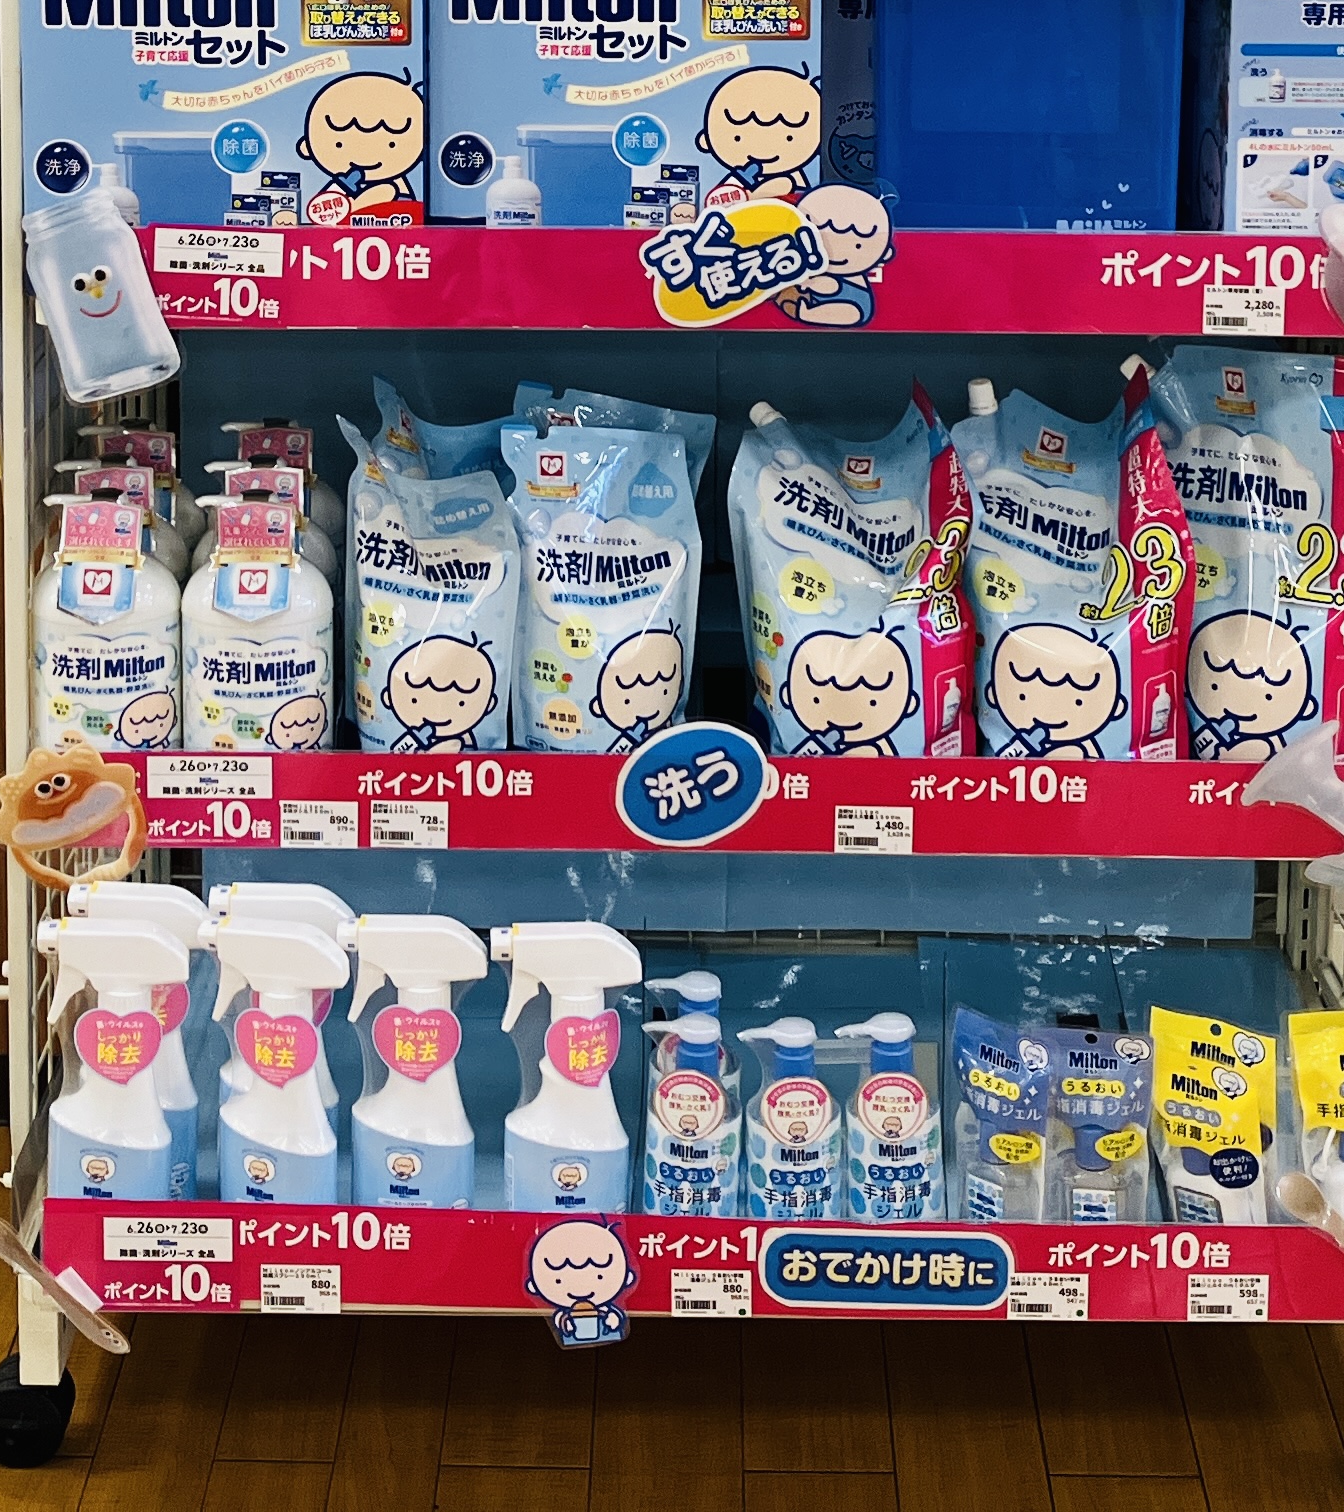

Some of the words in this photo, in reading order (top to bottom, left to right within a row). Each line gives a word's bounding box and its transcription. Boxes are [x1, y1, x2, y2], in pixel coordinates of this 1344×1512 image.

[134, 31, 185, 47] ミルトン
[186, 31, 286, 66] セット
[539, 26, 589, 42] ミルトン
[589, 25, 687, 61] セット
[539, 44, 592, 58] 子育て応援
[134, 50, 189, 63] 子育て応援
[222, 138, 259, 156] 除菌
[623, 132, 660, 150] 除菌
[44, 159, 81, 177] 洗浄
[449, 151, 485, 169] 洗浄
[650, 217, 733, 283] すぐ
[700, 226, 819, 301] 使える!
[1229, 470, 1308, 511] Milton
[774, 477, 844, 529] 洗剤
[847, 516, 914, 556] Milton
[1032, 513, 1111, 551] Milton
[356, 530, 419, 579] 洗剤
[425, 559, 492, 583] Milton
[537, 547, 591, 586] 洗剤
[595, 551, 672, 583] Milton
[928, 596, 959, 633] 倍
[1147, 602, 1176, 643] 倍
[52, 654, 99, 681] 洗剤
[104, 655, 165, 679] Milton
[203, 656, 250, 684] 洗剤
[255, 659, 316, 683] Milton
[358, 760, 533, 797] ポイント10倍
[643, 750, 740, 820] 洗う
[910, 766, 1088, 803] ポイント10倍
[147, 800, 272, 839] ポイント10倍
[97, 1043, 142, 1065] 除去
[254, 1048, 297, 1069] 除去
[395, 1042, 439, 1064] 除去
[568, 1048, 608, 1070] 除去
[980, 1044, 1020, 1074] Milton
[1069, 1051, 1118, 1070] Milton
[971, 1072, 1018, 1097] うるおい
[1065, 1080, 1122, 1094] うるおい
[1170, 1073, 1218, 1102] Milton
[1166, 1100, 1220, 1124] うるおい
[670, 1143, 709, 1159] Milton
[780, 1148, 819, 1163] Milton
[878, 1144, 918, 1157] Milton
[661, 1165, 713, 1181] うるおい
[771, 1169, 825, 1184] うるおい
[870, 1164, 924, 1180] うるおい
[654, 1179, 723, 1205] 手指消毒
[764, 1187, 833, 1207] 手指消毒
[863, 1182, 932, 1205] 手指消毒
[638, 1227, 758, 1262] ポイント1
[1048, 1232, 1232, 1270] ポイント10倍
[782, 1249, 994, 1288] おでかけ時に
[104, 1264, 232, 1303] ポイント10倍
